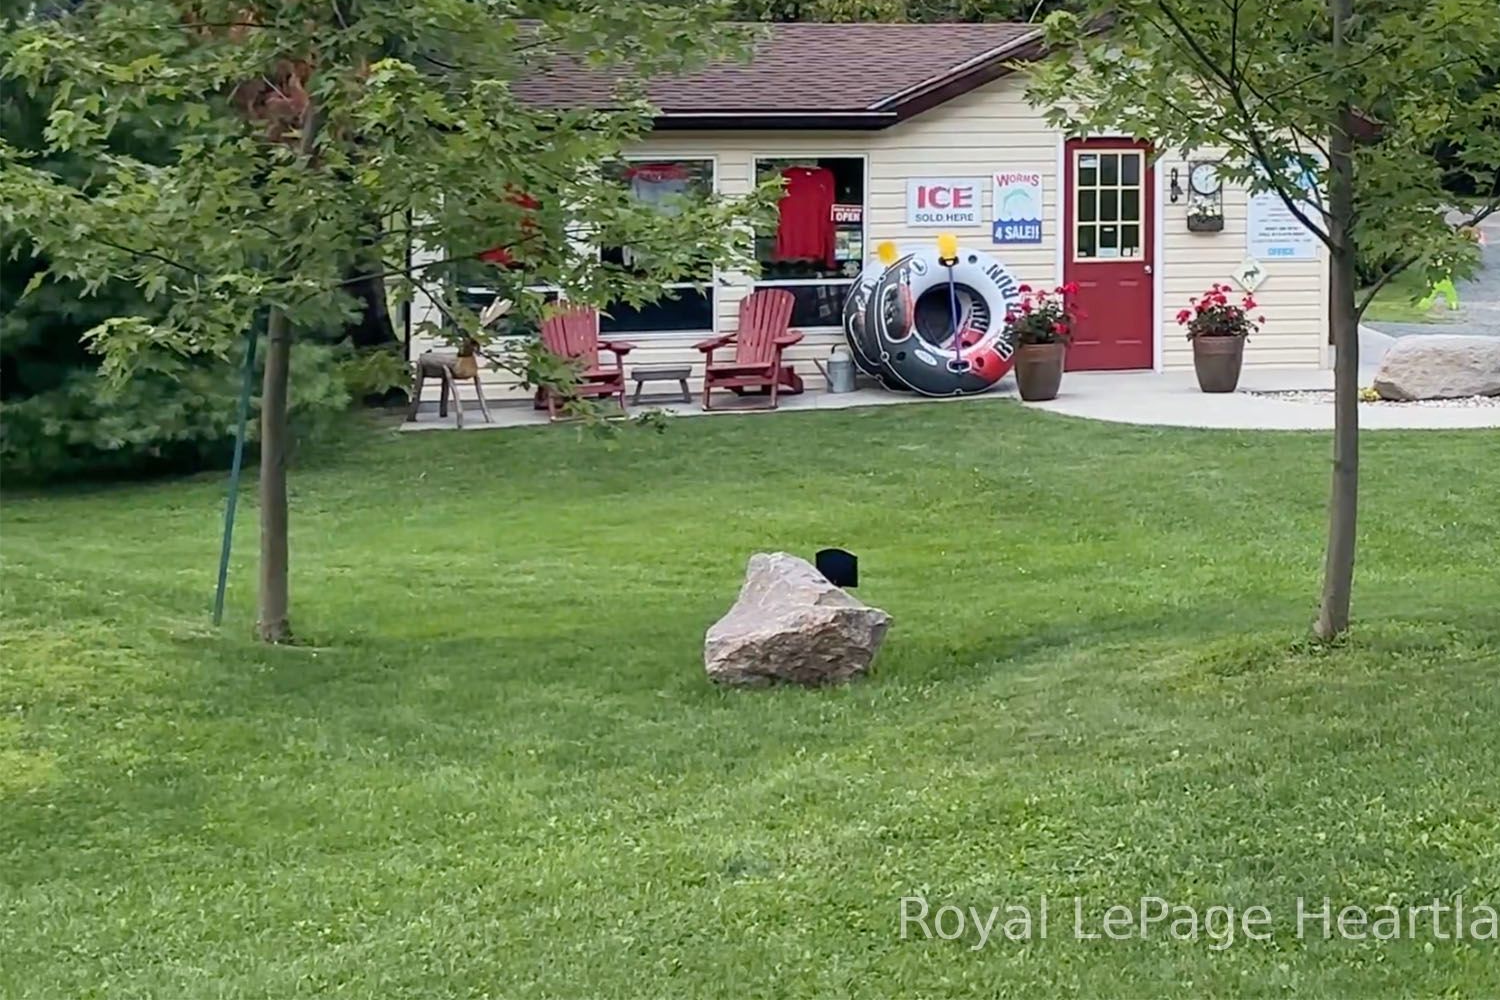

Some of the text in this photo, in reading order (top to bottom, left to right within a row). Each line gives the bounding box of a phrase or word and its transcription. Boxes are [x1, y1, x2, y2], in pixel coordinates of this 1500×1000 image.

[917, 186, 973, 209] ICE
[835, 212, 860, 222] OPEN
[915, 213, 974, 222] SOLD HERE
[995, 226, 1002, 240] 4
[986, 264, 1020, 300] RUN
